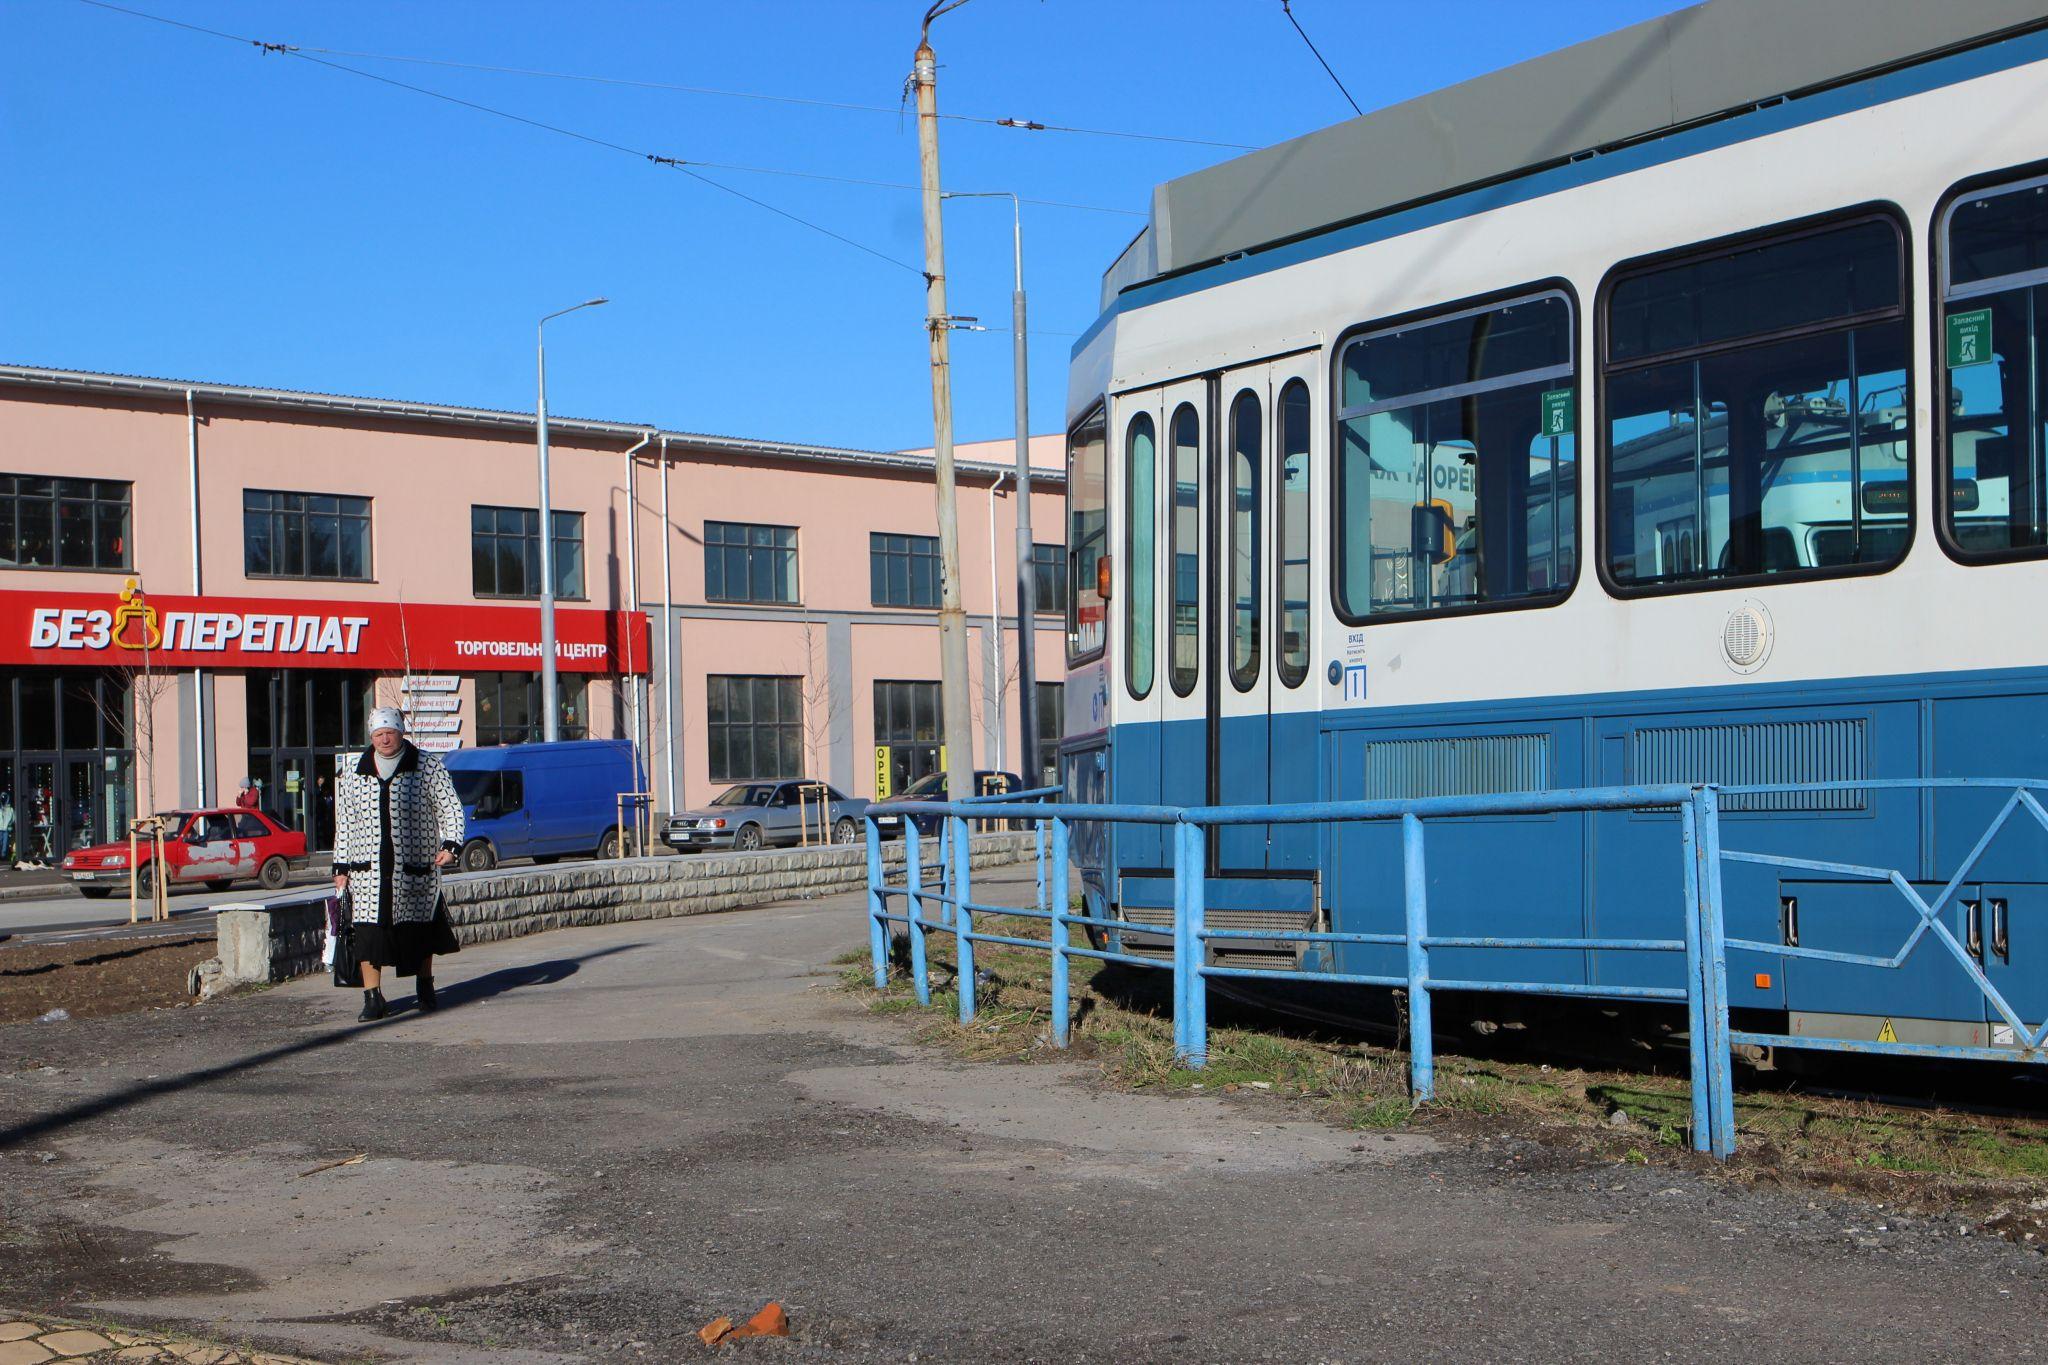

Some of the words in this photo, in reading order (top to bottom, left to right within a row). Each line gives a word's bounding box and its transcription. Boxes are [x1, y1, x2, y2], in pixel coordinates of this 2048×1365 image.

[30, 608, 112, 649] БЕЗ
[161, 611, 369, 653] ПЕРЕПЛАТ
[455, 640, 559, 657] ТОРГОВЕЛЬНЙ
[564, 643, 607, 660] ЦЕНТР
[877, 748, 886, 799] ОРЕН
